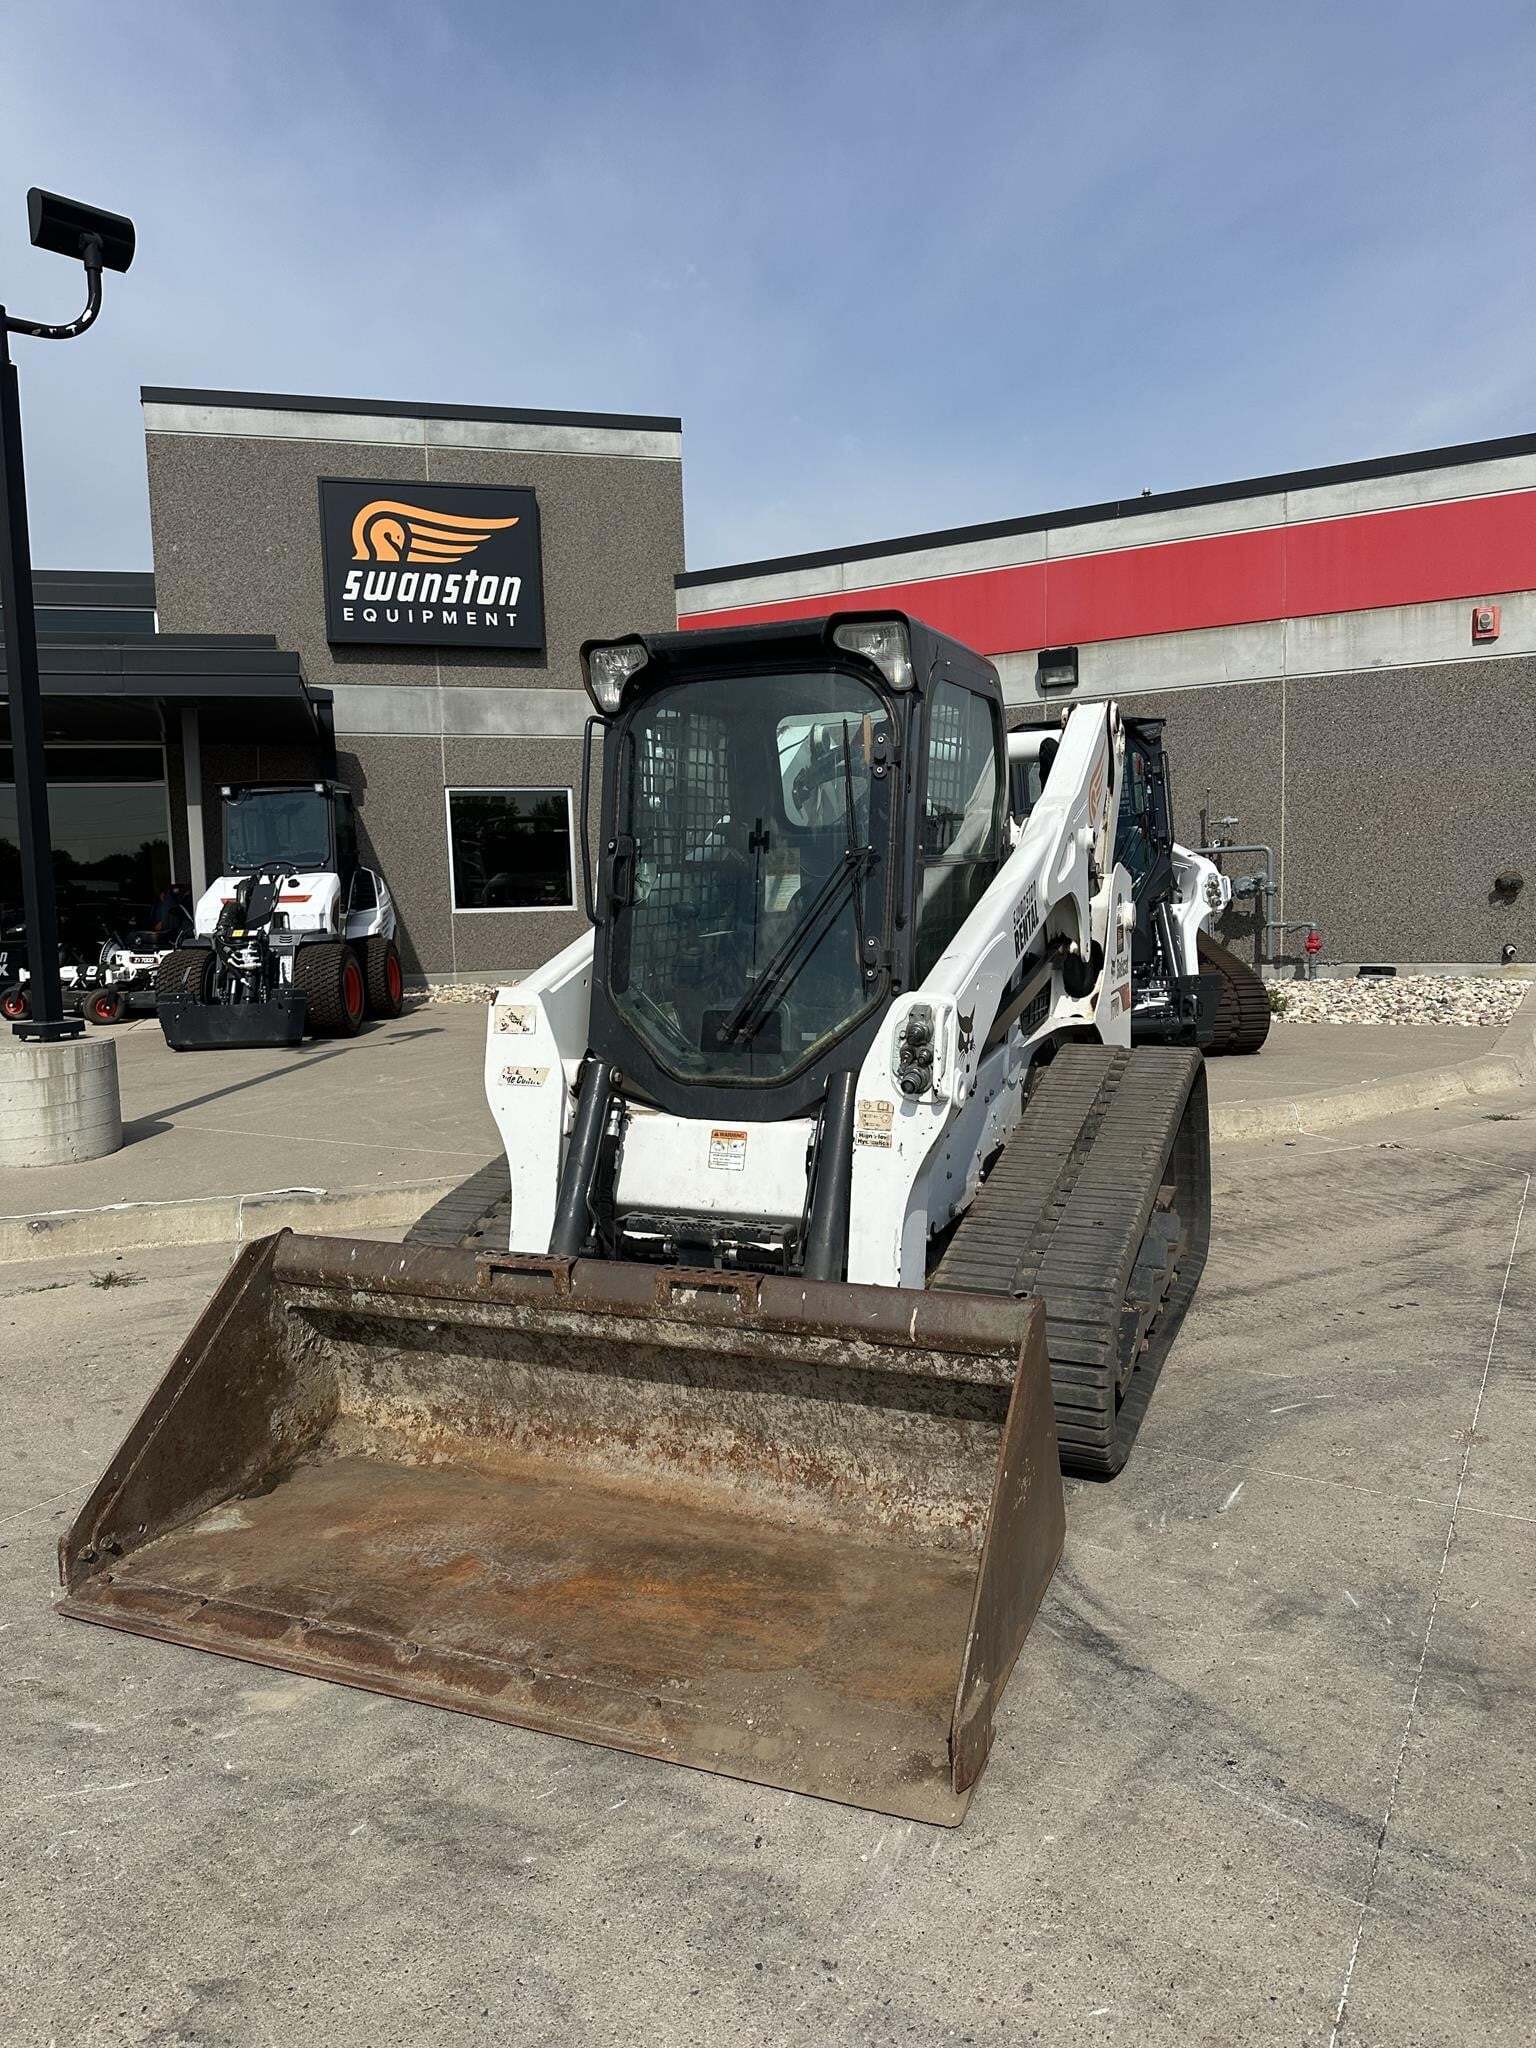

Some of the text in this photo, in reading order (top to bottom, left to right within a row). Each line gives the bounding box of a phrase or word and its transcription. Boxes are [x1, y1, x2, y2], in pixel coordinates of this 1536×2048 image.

[343, 607, 518, 627] EQUIPMENT
[1013, 899, 1040, 960] RENTAL
[719, 1131, 745, 1139] WARNING
